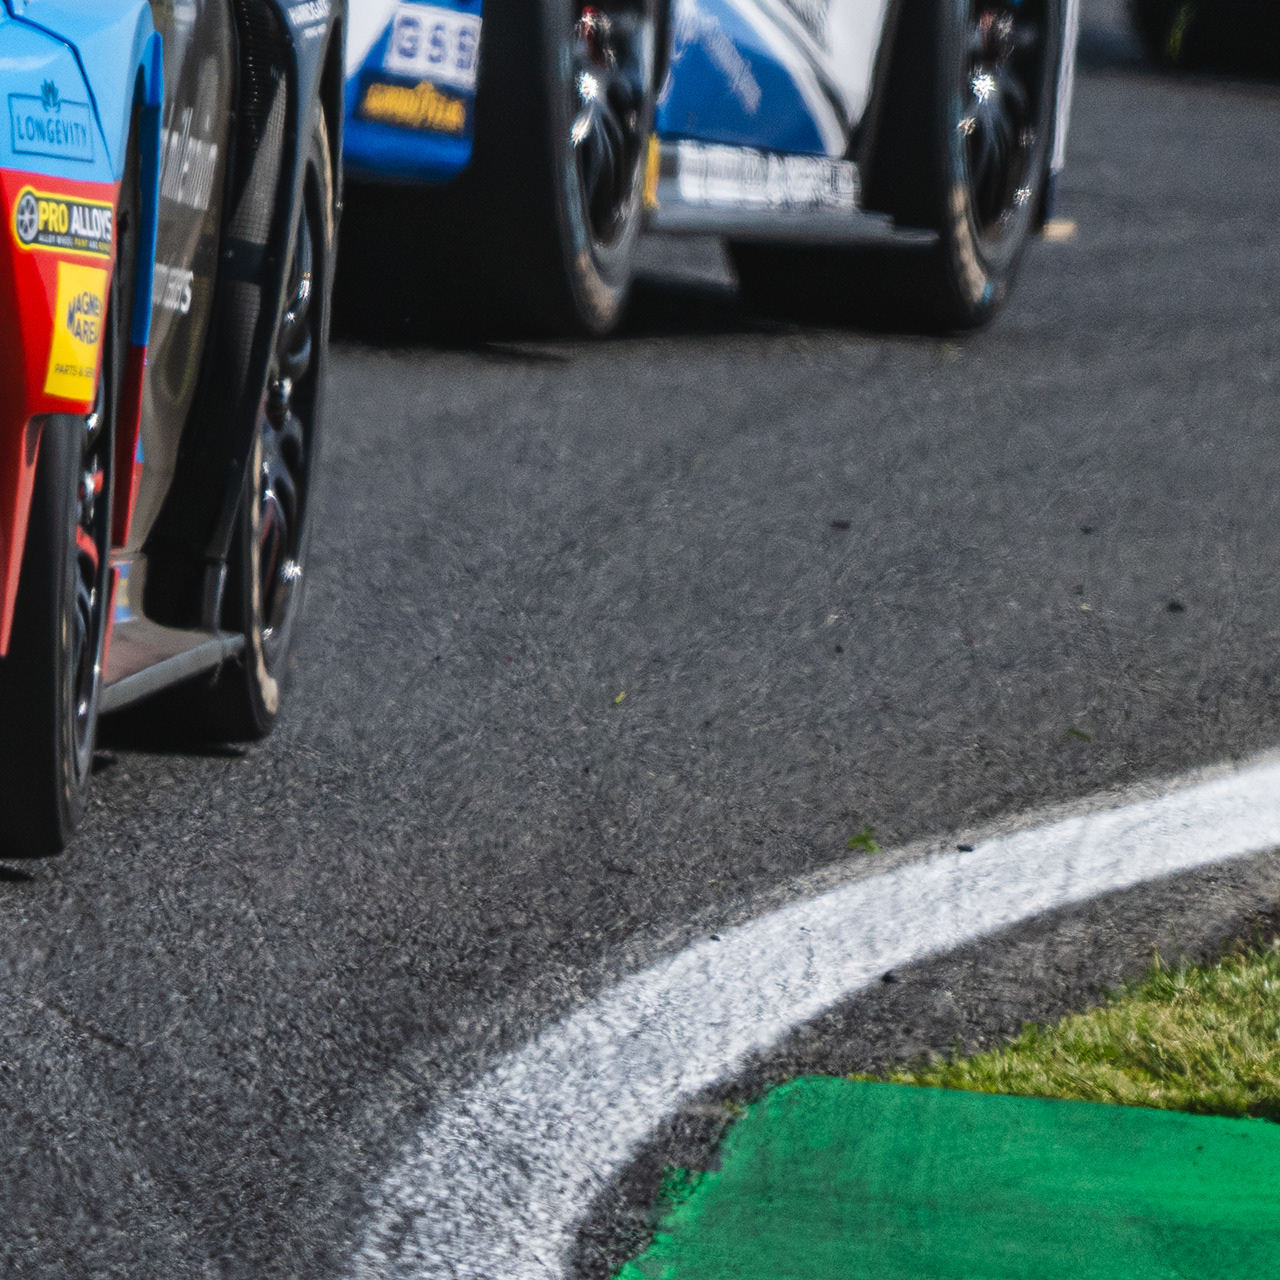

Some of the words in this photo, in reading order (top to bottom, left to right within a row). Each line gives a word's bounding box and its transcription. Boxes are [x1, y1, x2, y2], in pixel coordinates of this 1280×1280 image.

[16, 114, 88, 148] LONGEVITY
[38, 200, 69, 235] PRO
[71, 206, 112, 242] ALLOYS
